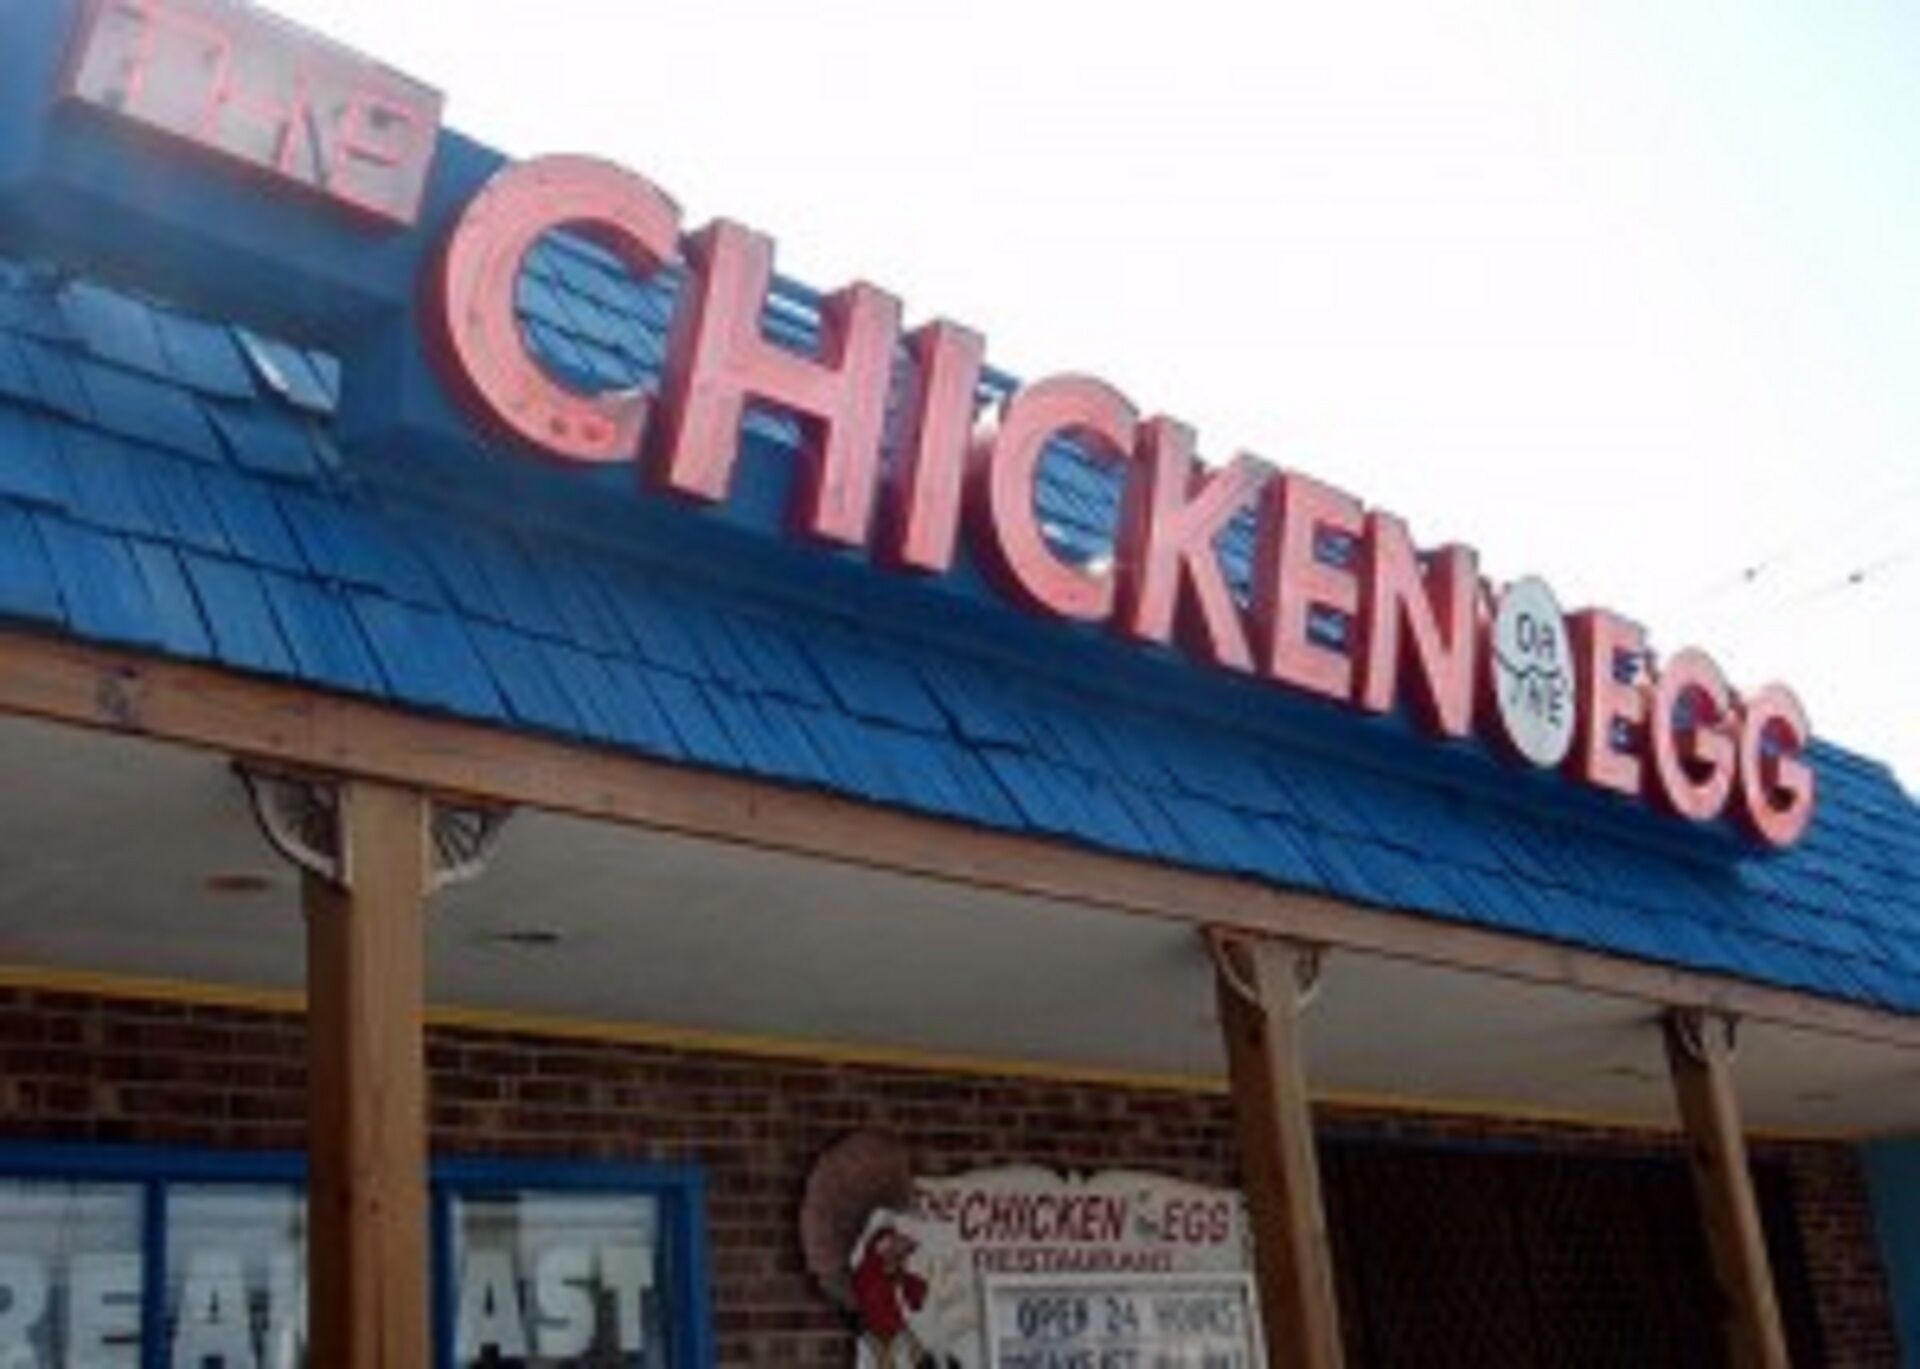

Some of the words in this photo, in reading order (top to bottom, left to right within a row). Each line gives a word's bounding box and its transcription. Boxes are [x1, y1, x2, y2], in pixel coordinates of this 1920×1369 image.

[440, 154, 1475, 737] CHICKEN
[1586, 606, 1816, 848] EGG
[959, 1190, 1128, 1242] CHICKEN
[1161, 1200, 1230, 1243] EGG
[1017, 1297, 1088, 1337] OPEN
